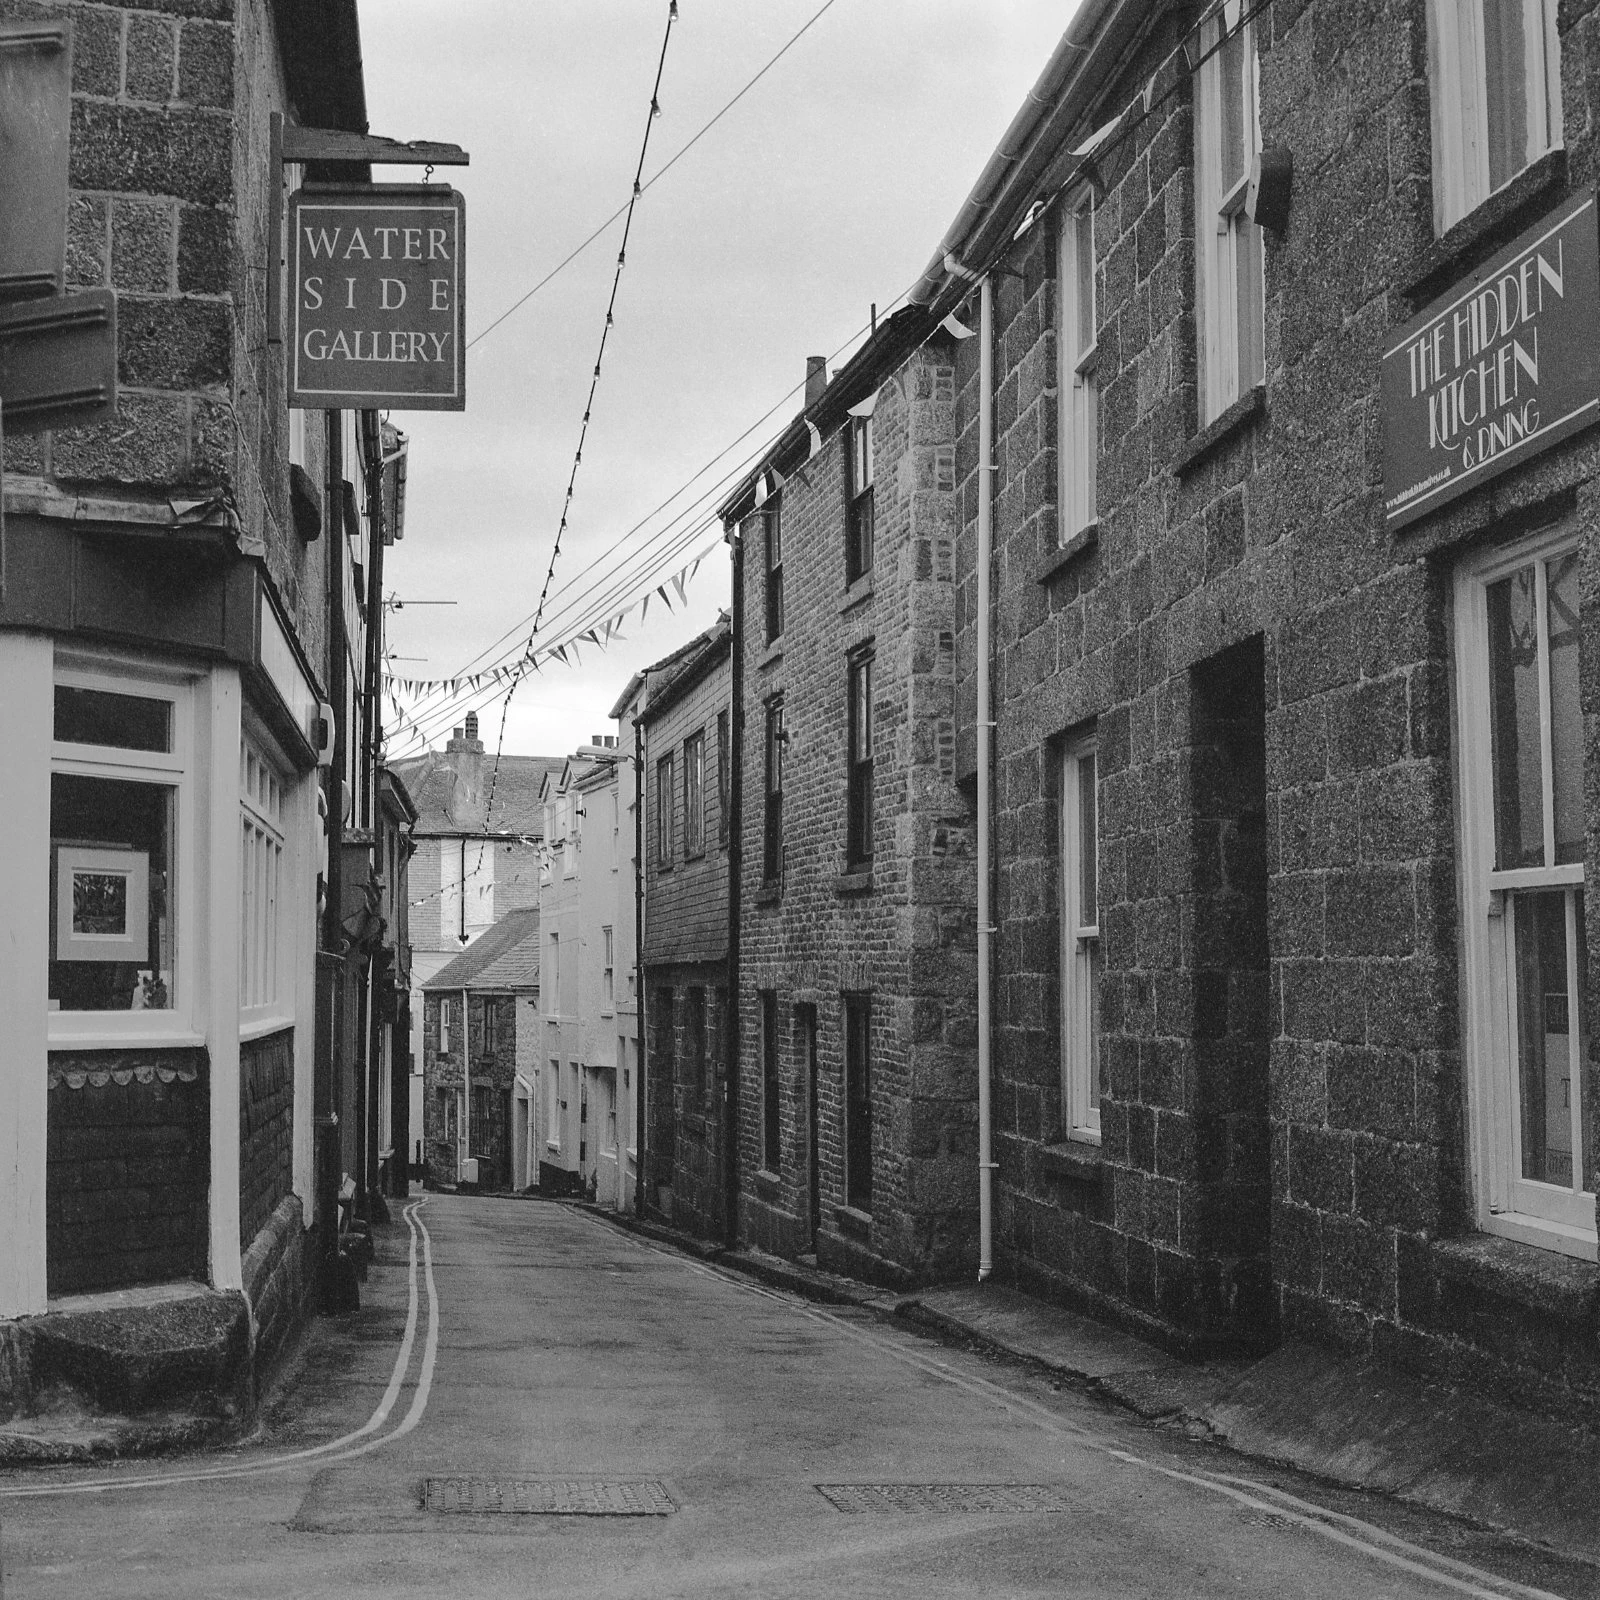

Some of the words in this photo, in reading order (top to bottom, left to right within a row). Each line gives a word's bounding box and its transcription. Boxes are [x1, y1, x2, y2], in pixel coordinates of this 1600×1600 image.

[304, 227, 451, 260] WATER
[304, 277, 450, 311] SIDE
[1407, 322, 1447, 398] THE
[1453, 238, 1564, 368] HIDDEN
[303, 329, 451, 363] GALLERY
[1429, 326, 1539, 449] KITCHEN
[1463, 436, 1475, 469] &
[1478, 398, 1540, 462] DINING
